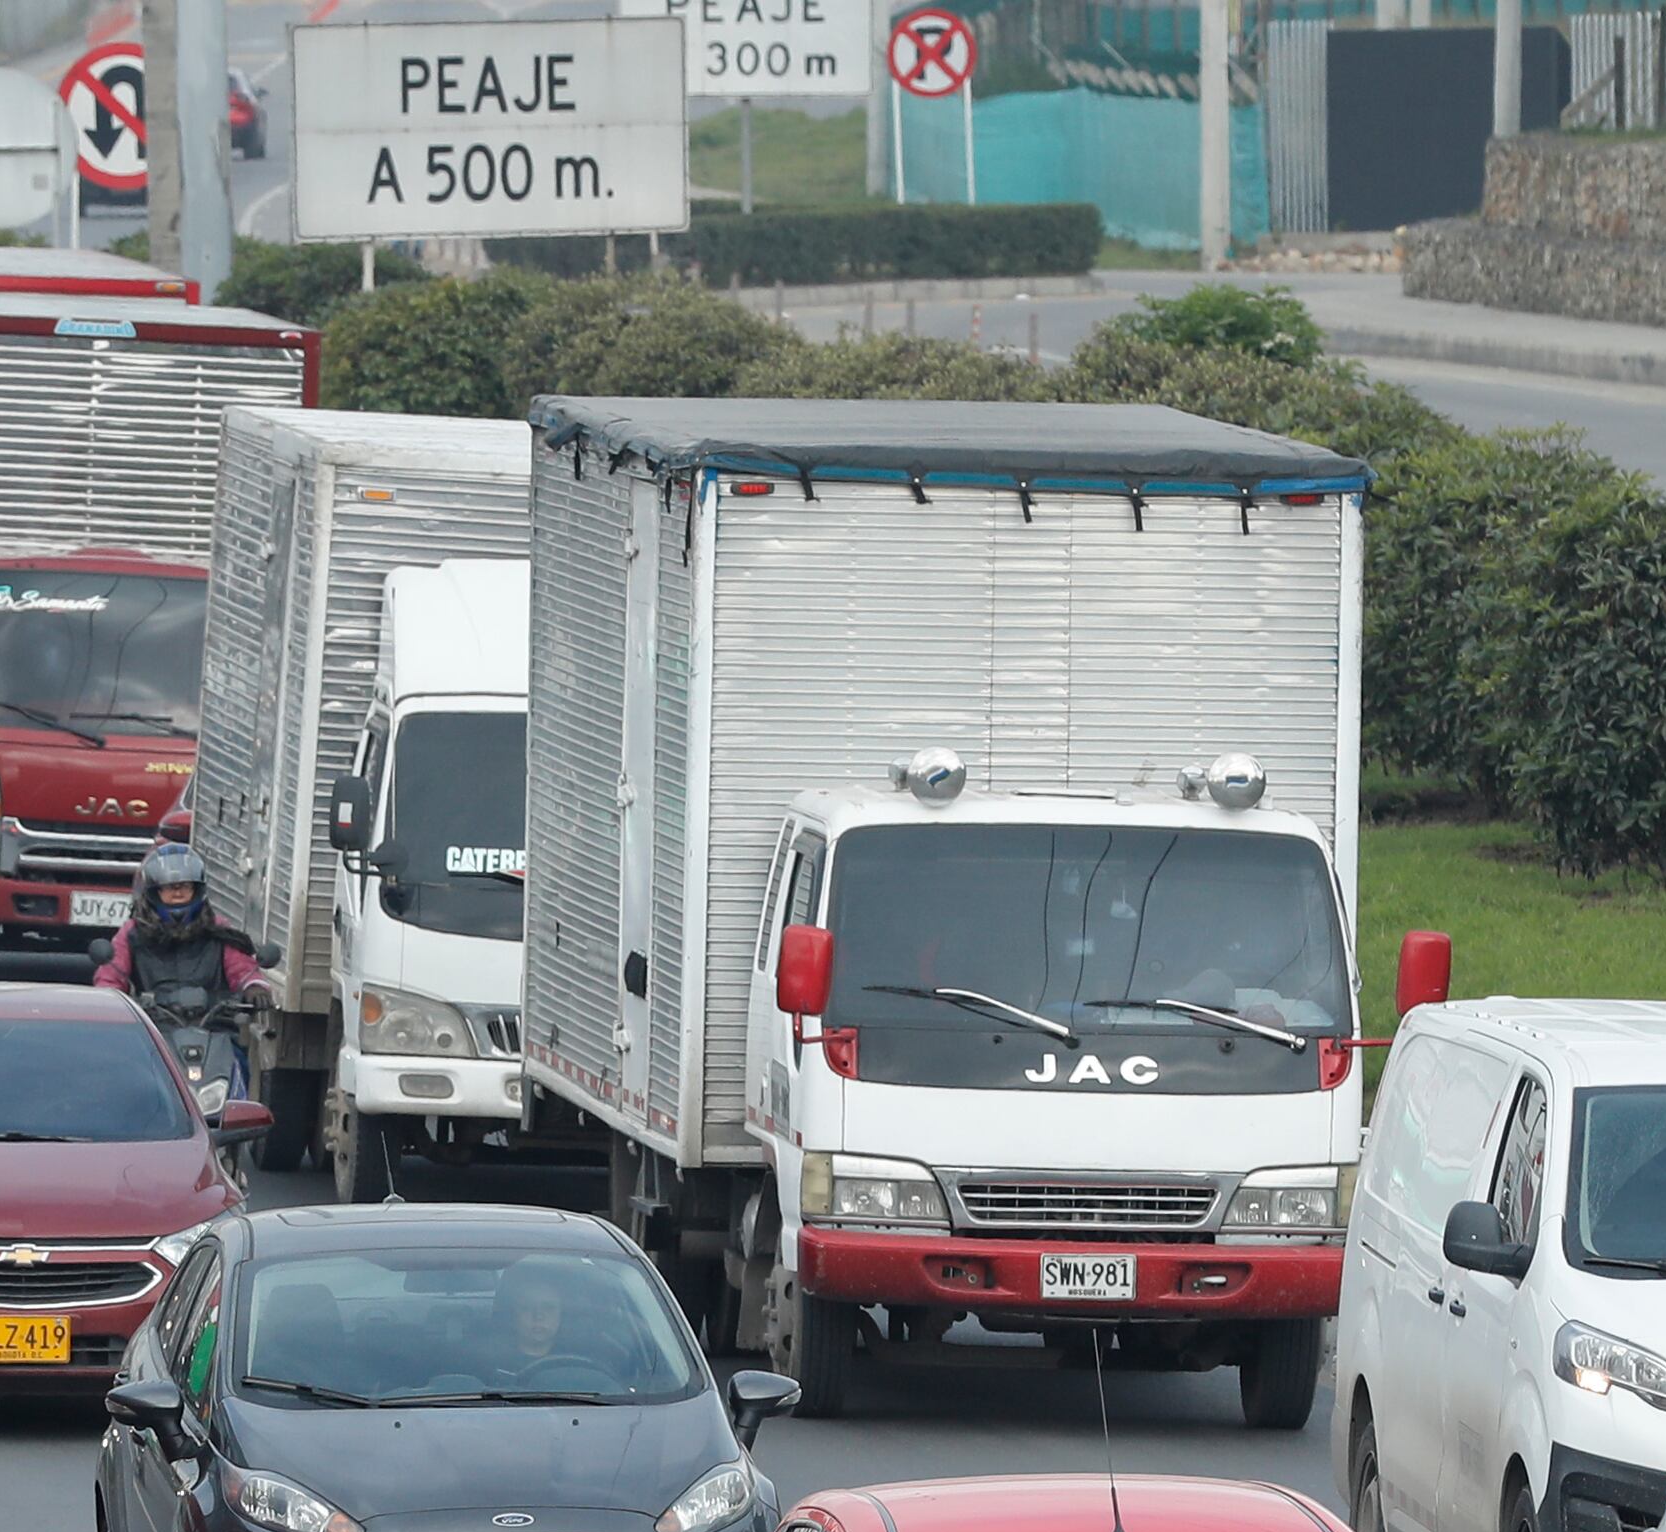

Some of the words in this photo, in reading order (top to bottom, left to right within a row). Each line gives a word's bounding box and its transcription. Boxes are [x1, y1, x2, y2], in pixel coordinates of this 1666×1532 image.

[706, 42, 791, 76] 300
[804, 54, 837, 76] m
[401, 55, 576, 113] PEAJE
[367, 146, 405, 203] A
[426, 144, 534, 203] 500
[555, 156, 614, 198] m.
[75, 796, 149, 818] JAC
[1024, 1053, 1160, 1085] JAC
